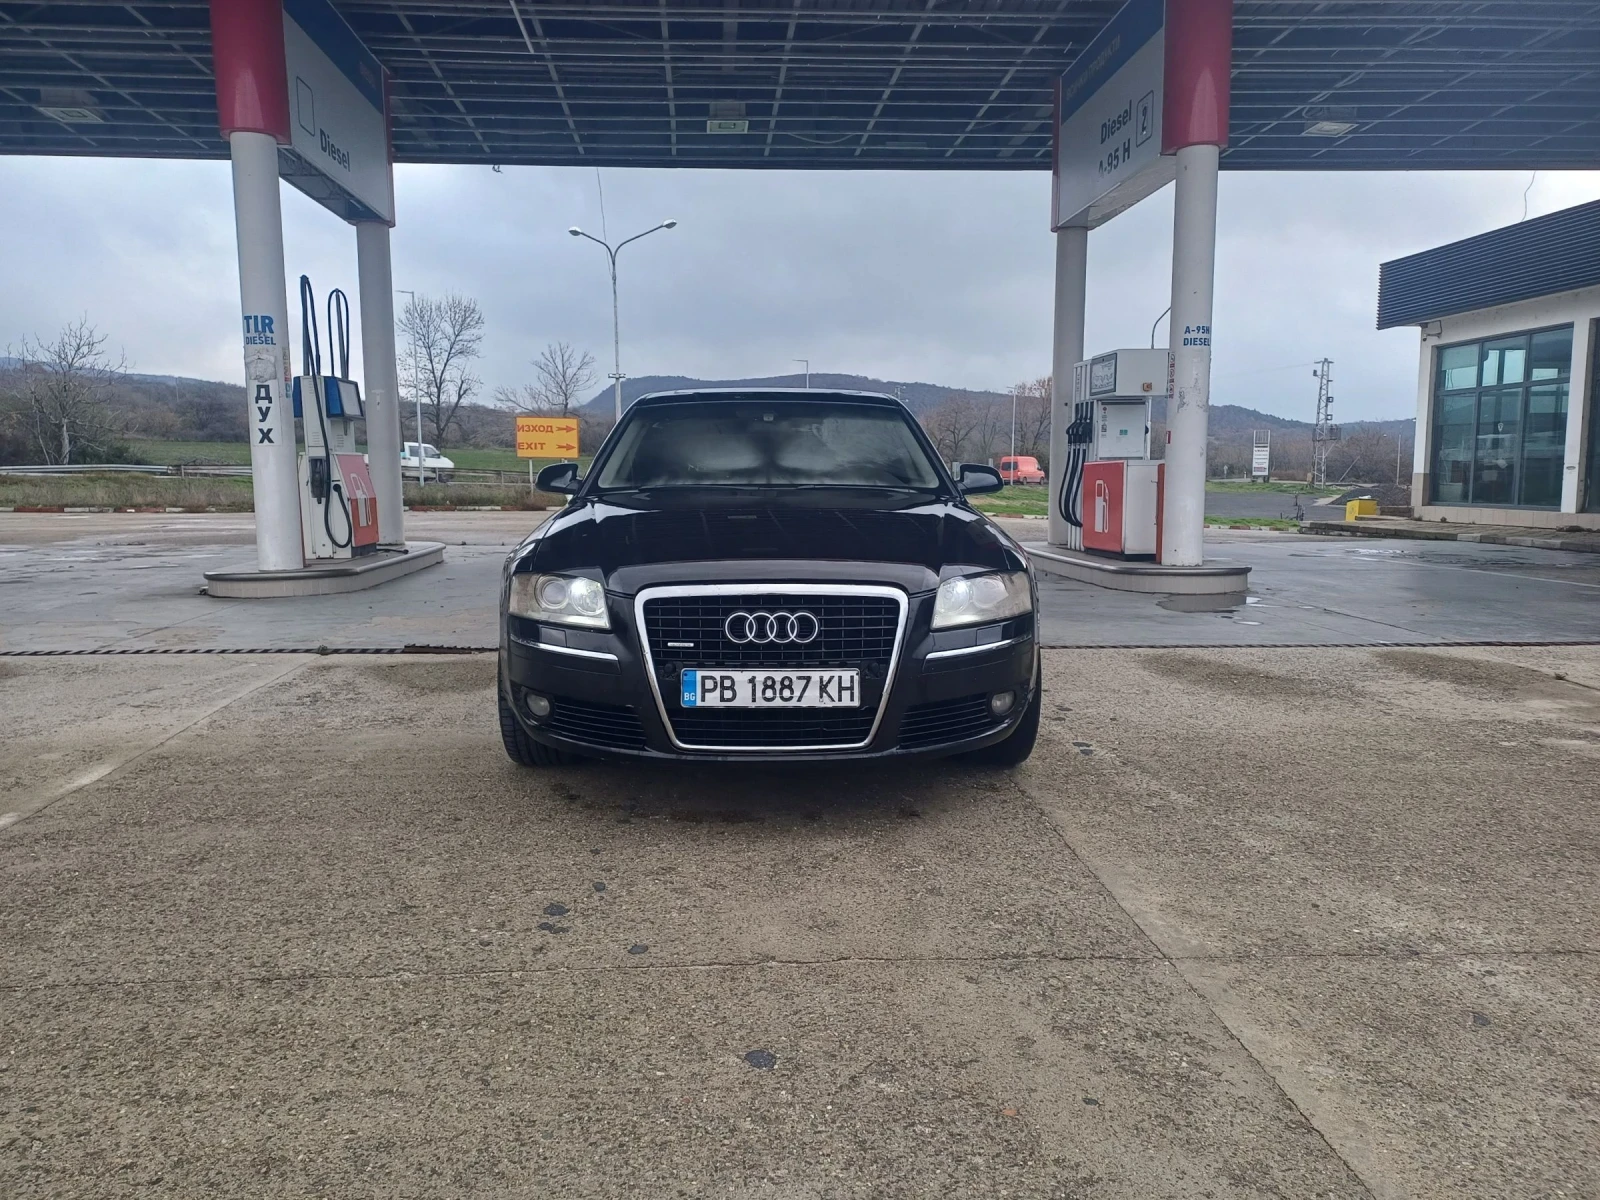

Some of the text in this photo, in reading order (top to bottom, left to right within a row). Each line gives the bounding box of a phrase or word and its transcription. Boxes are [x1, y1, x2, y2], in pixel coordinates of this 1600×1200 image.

[1100, 99, 1132, 145] Diesel
[319, 127, 351, 173] Diesel
[243, 315, 275, 334] TIR
[245, 335, 277, 346] DIESEL
[1183, 337, 1210, 347] DIESEL
[517, 424, 554, 433] ИЗХОД
[517, 442, 546, 450] EXIT
[700, 674, 856, 703] PB 1887 KH
[684, 692, 696, 701] BG
